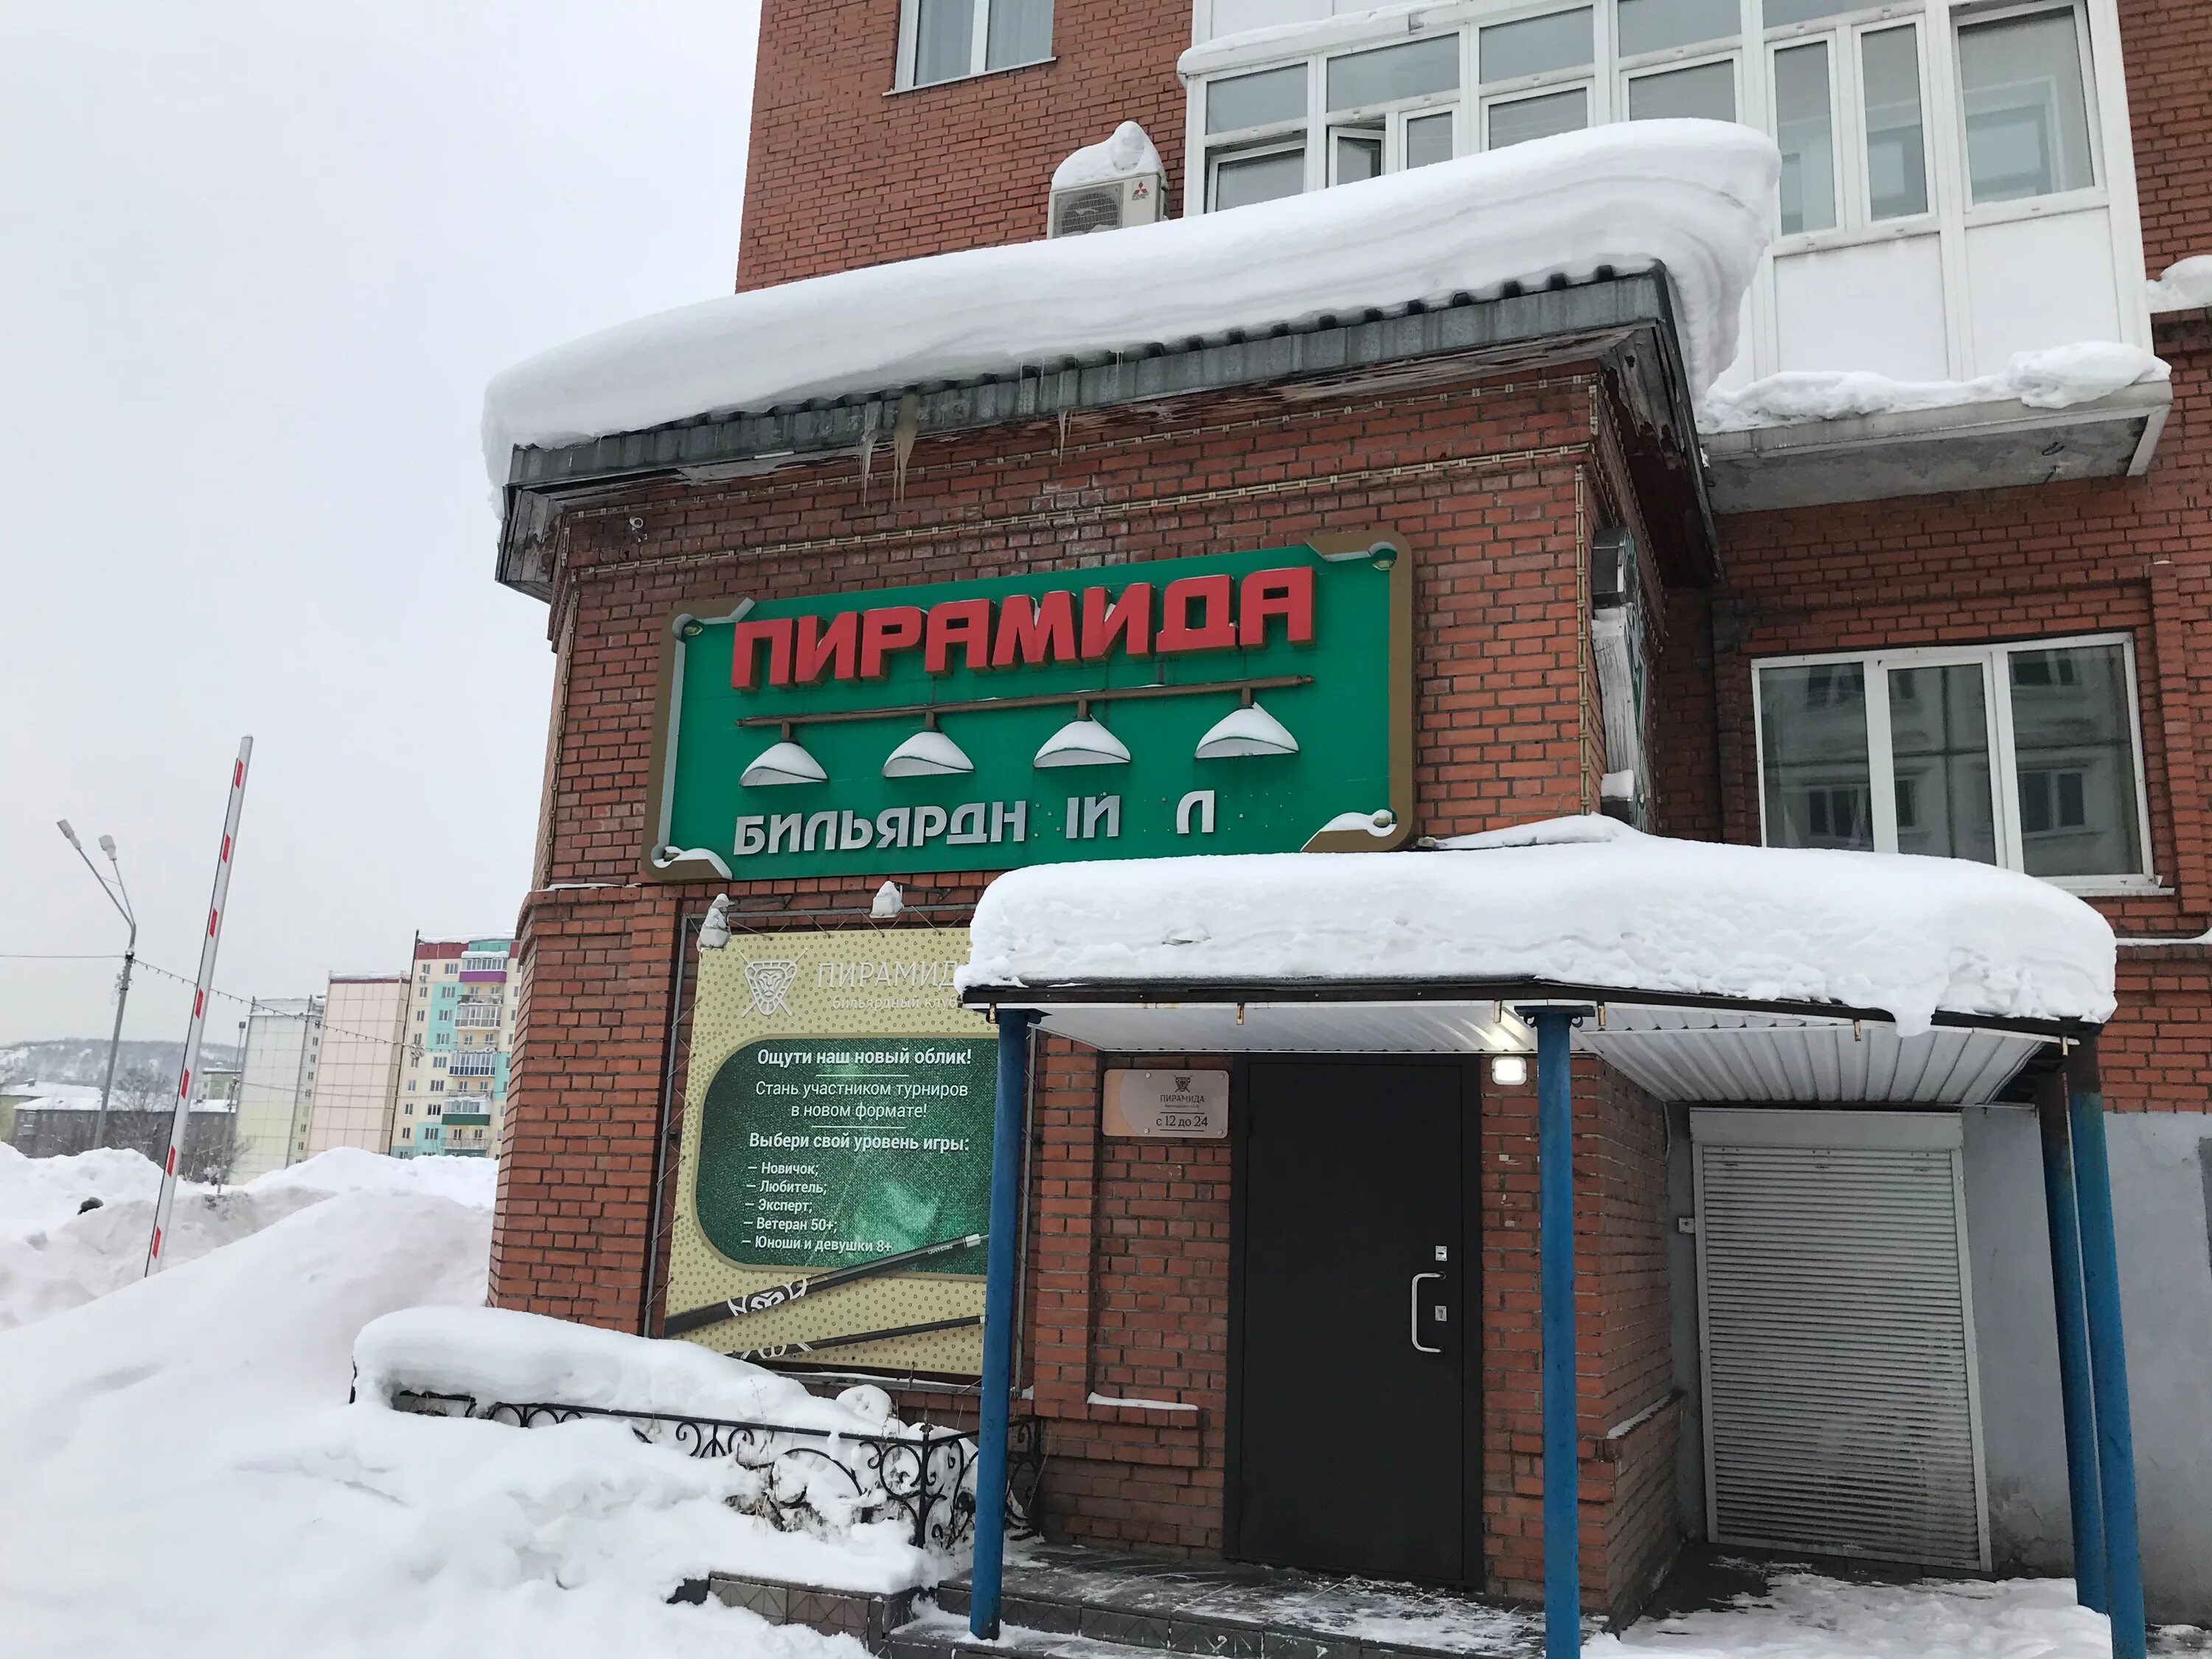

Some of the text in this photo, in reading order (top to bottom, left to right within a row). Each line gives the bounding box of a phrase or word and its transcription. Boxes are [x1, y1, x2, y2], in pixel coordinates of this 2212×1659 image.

[731, 566, 1315, 692] ПИРАМИДА
[818, 961, 958, 992] ПИРАМИД
[833, 994, 958, 1012] бильярдный клуб
[757, 1048, 972, 1068] Ощути наш новый облик!
[756, 1081, 968, 1099] Стань участником турниров
[1160, 1095, 1205, 1103] ПИРАМИДА
[791, 1102, 927, 1120] в новом формате!
[1156, 1115, 1208, 1127] с 12 до 24
[749, 1133, 970, 1153] Выбери свой уровень игры:
[761, 1161, 818, 1176] Новичок;
[759, 1180, 827, 1195] Любитель;
[758, 1198, 813, 1214] Эксперт;
[757, 1217, 807, 1233] Ветеран
[810, 1218, 838, 1234] 50+;
[755, 1236, 801, 1249] Юноши
[804, 1241, 812, 1250] и
[815, 1241, 873, 1253] девушки
[876, 1240, 892, 1252] 8+
